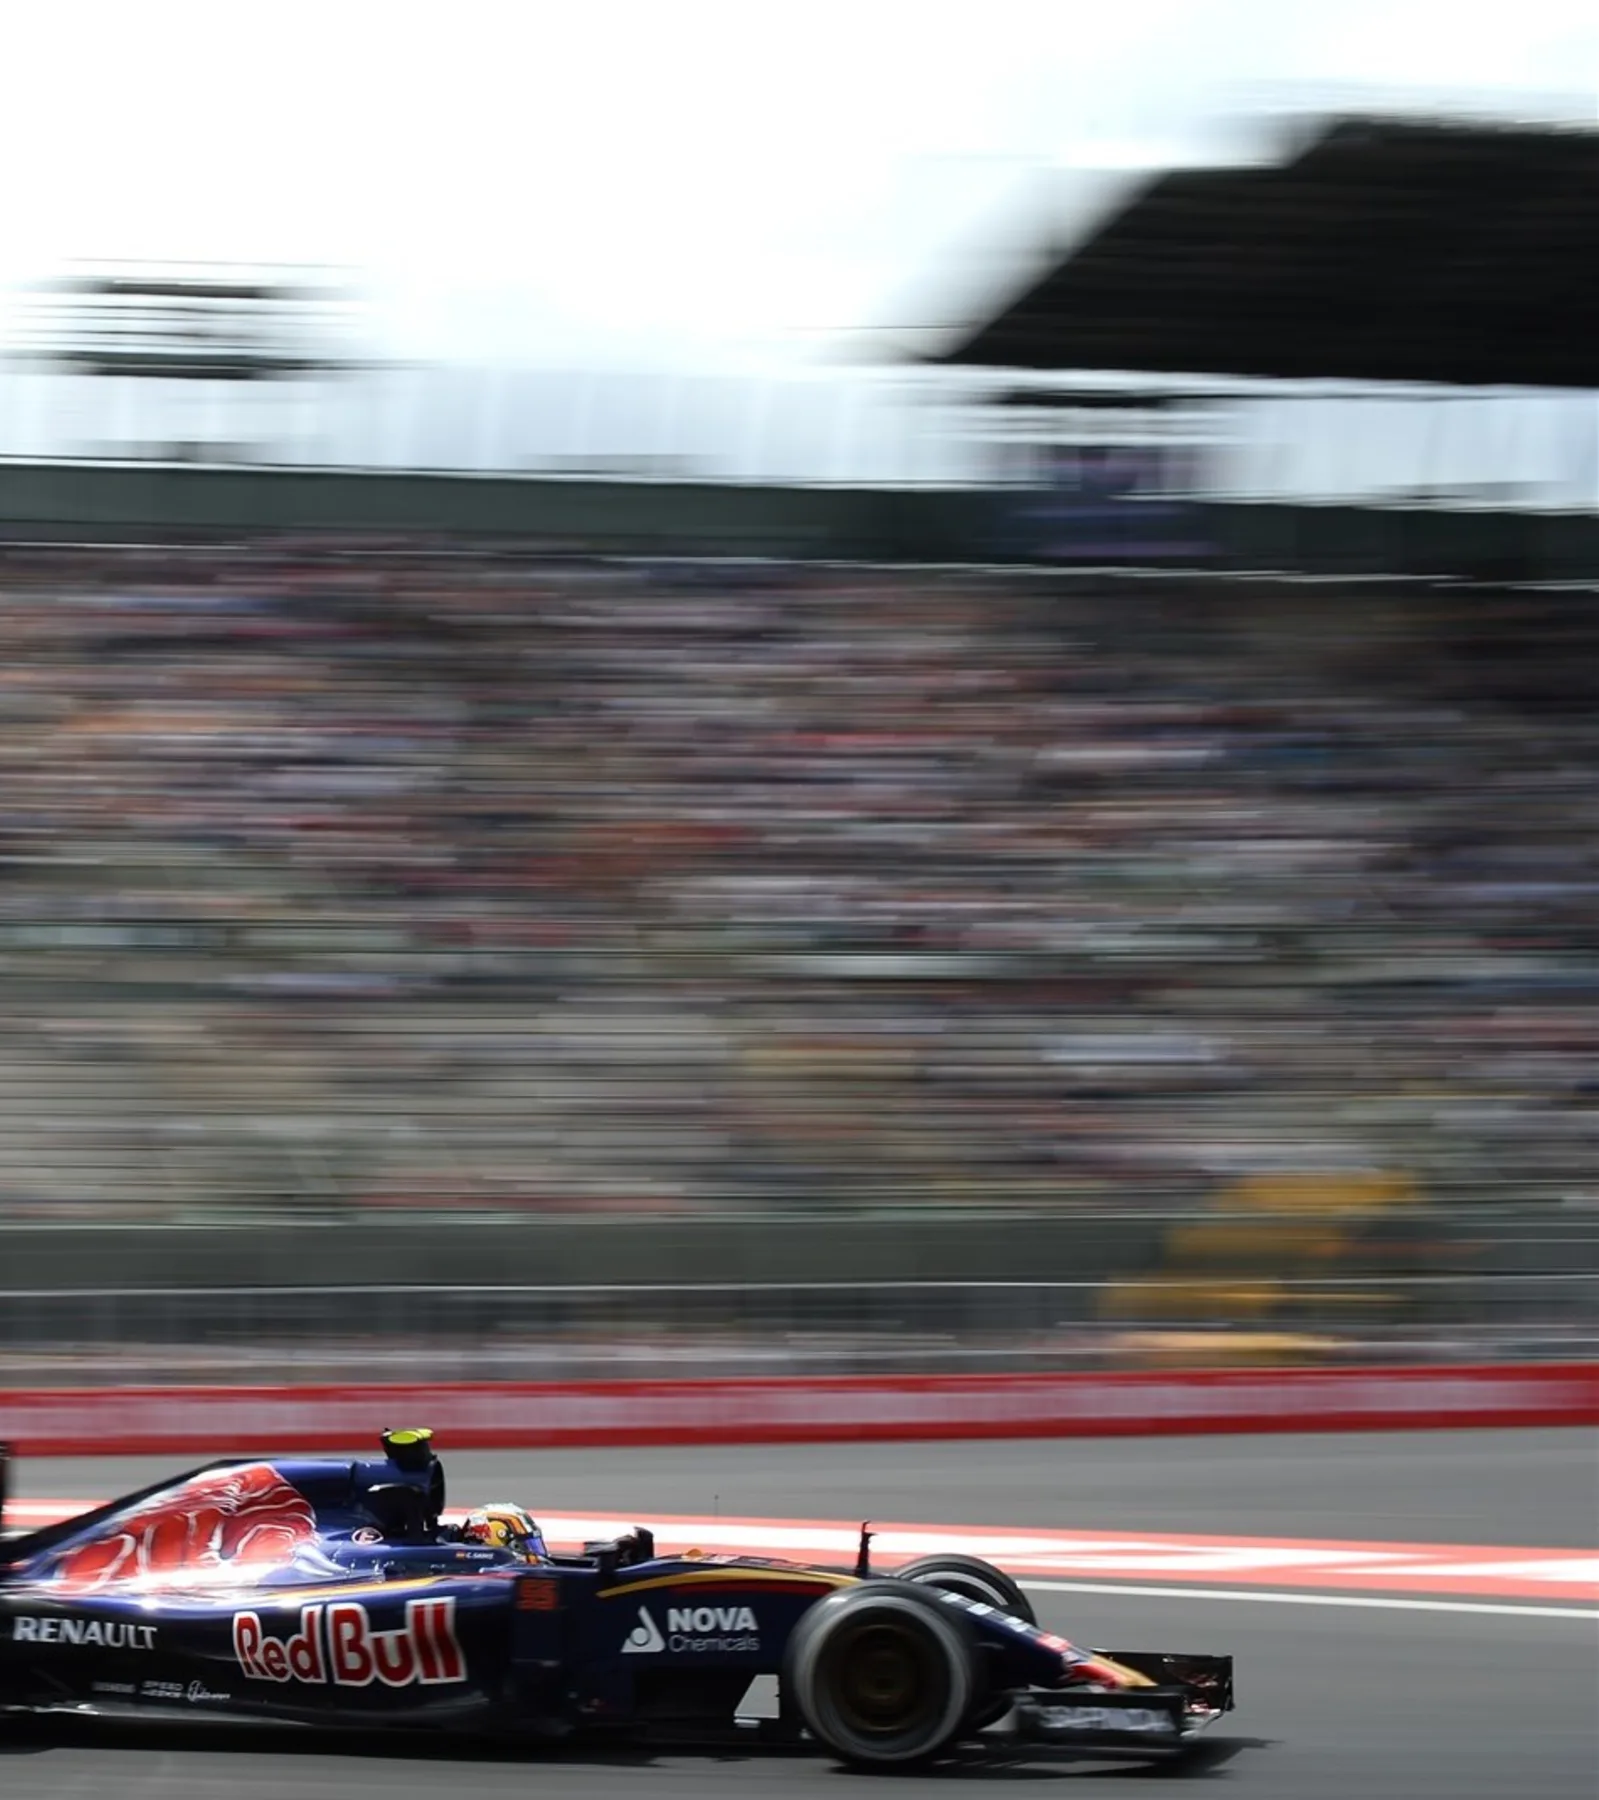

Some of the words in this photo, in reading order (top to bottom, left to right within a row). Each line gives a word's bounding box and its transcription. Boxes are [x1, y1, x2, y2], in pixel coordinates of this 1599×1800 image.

[12, 1616, 158, 1650] RENAULT
[667, 1607, 759, 1632] NOVA
[232, 1604, 327, 1683] Red
[326, 1596, 467, 1688] Bull
[668, 1634, 760, 1652] Chemicals
